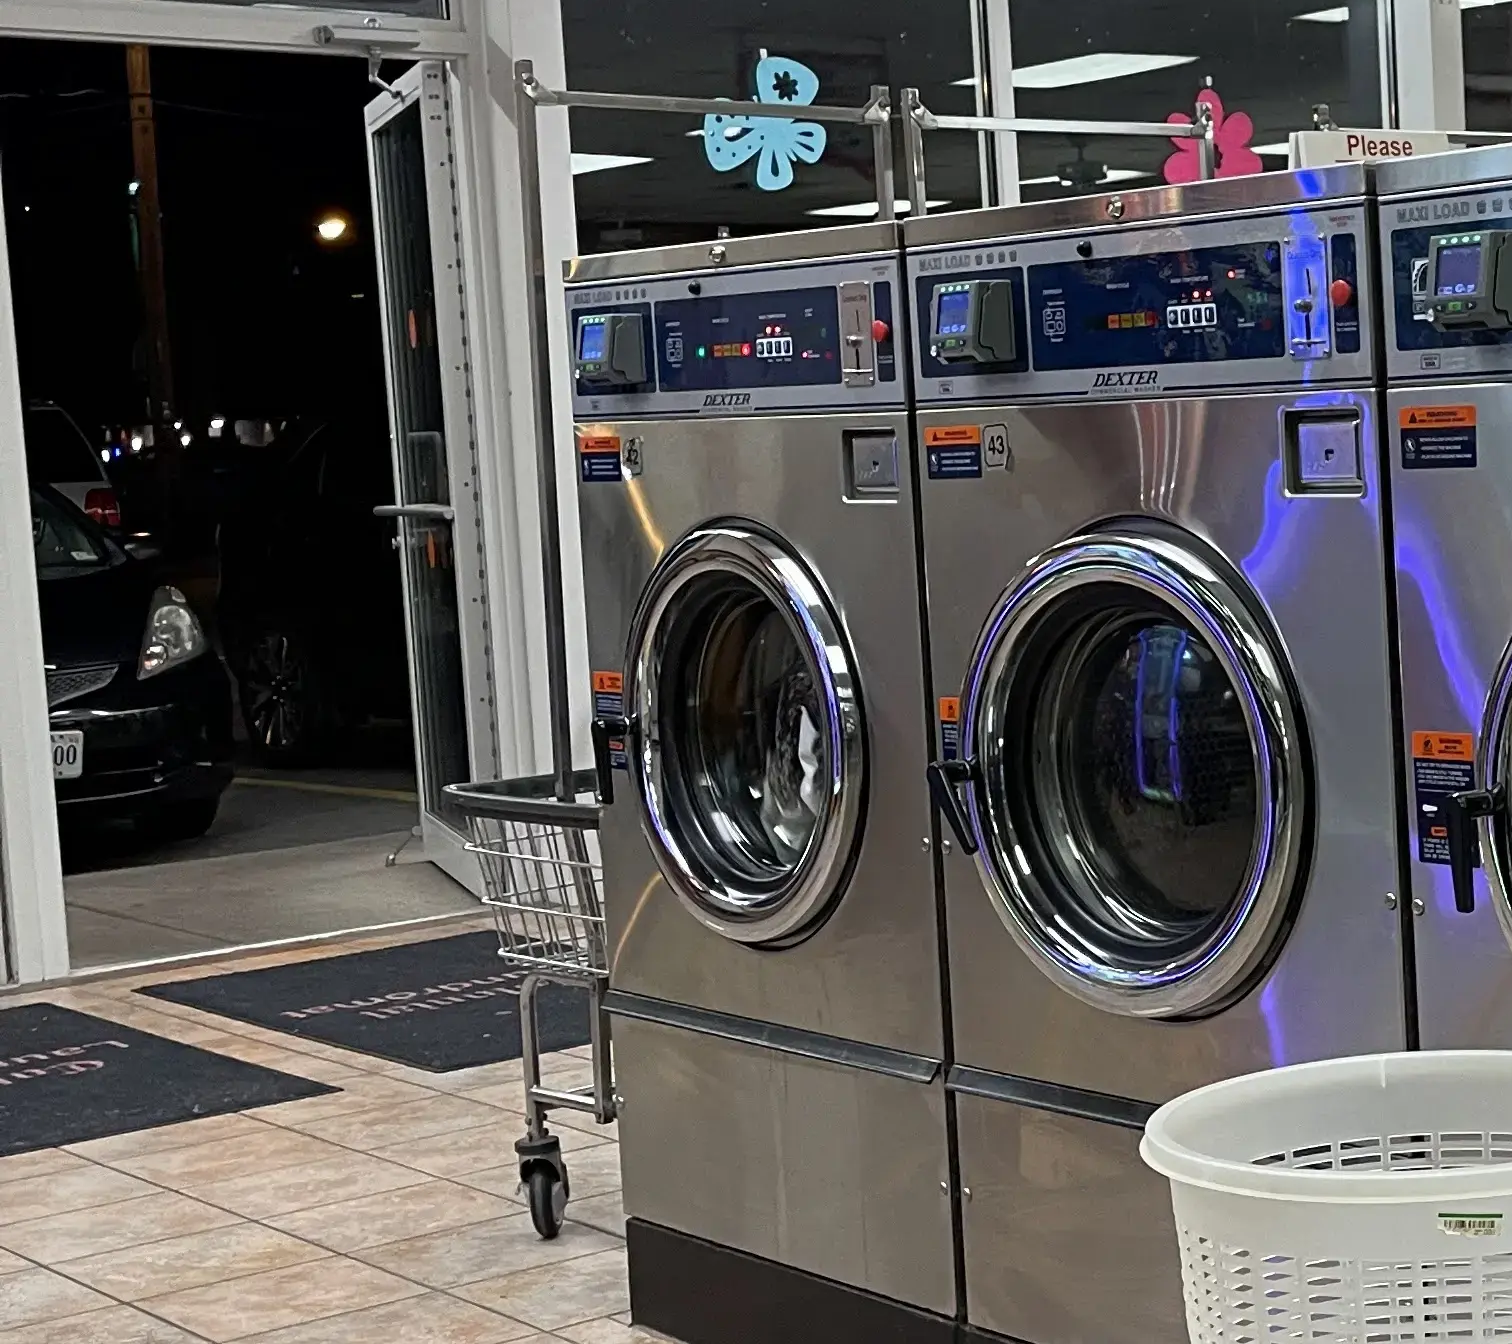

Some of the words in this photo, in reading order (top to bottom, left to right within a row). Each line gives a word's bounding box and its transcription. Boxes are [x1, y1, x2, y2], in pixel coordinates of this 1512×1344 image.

[1346, 134, 1413, 158] Please
[1433, 201, 1470, 220] LOAD
[1093, 370, 1158, 388] DEXTER
[703, 392, 751, 406] DEXTER
[988, 435, 1004, 455] 43
[280, 969, 529, 1019] undromat
